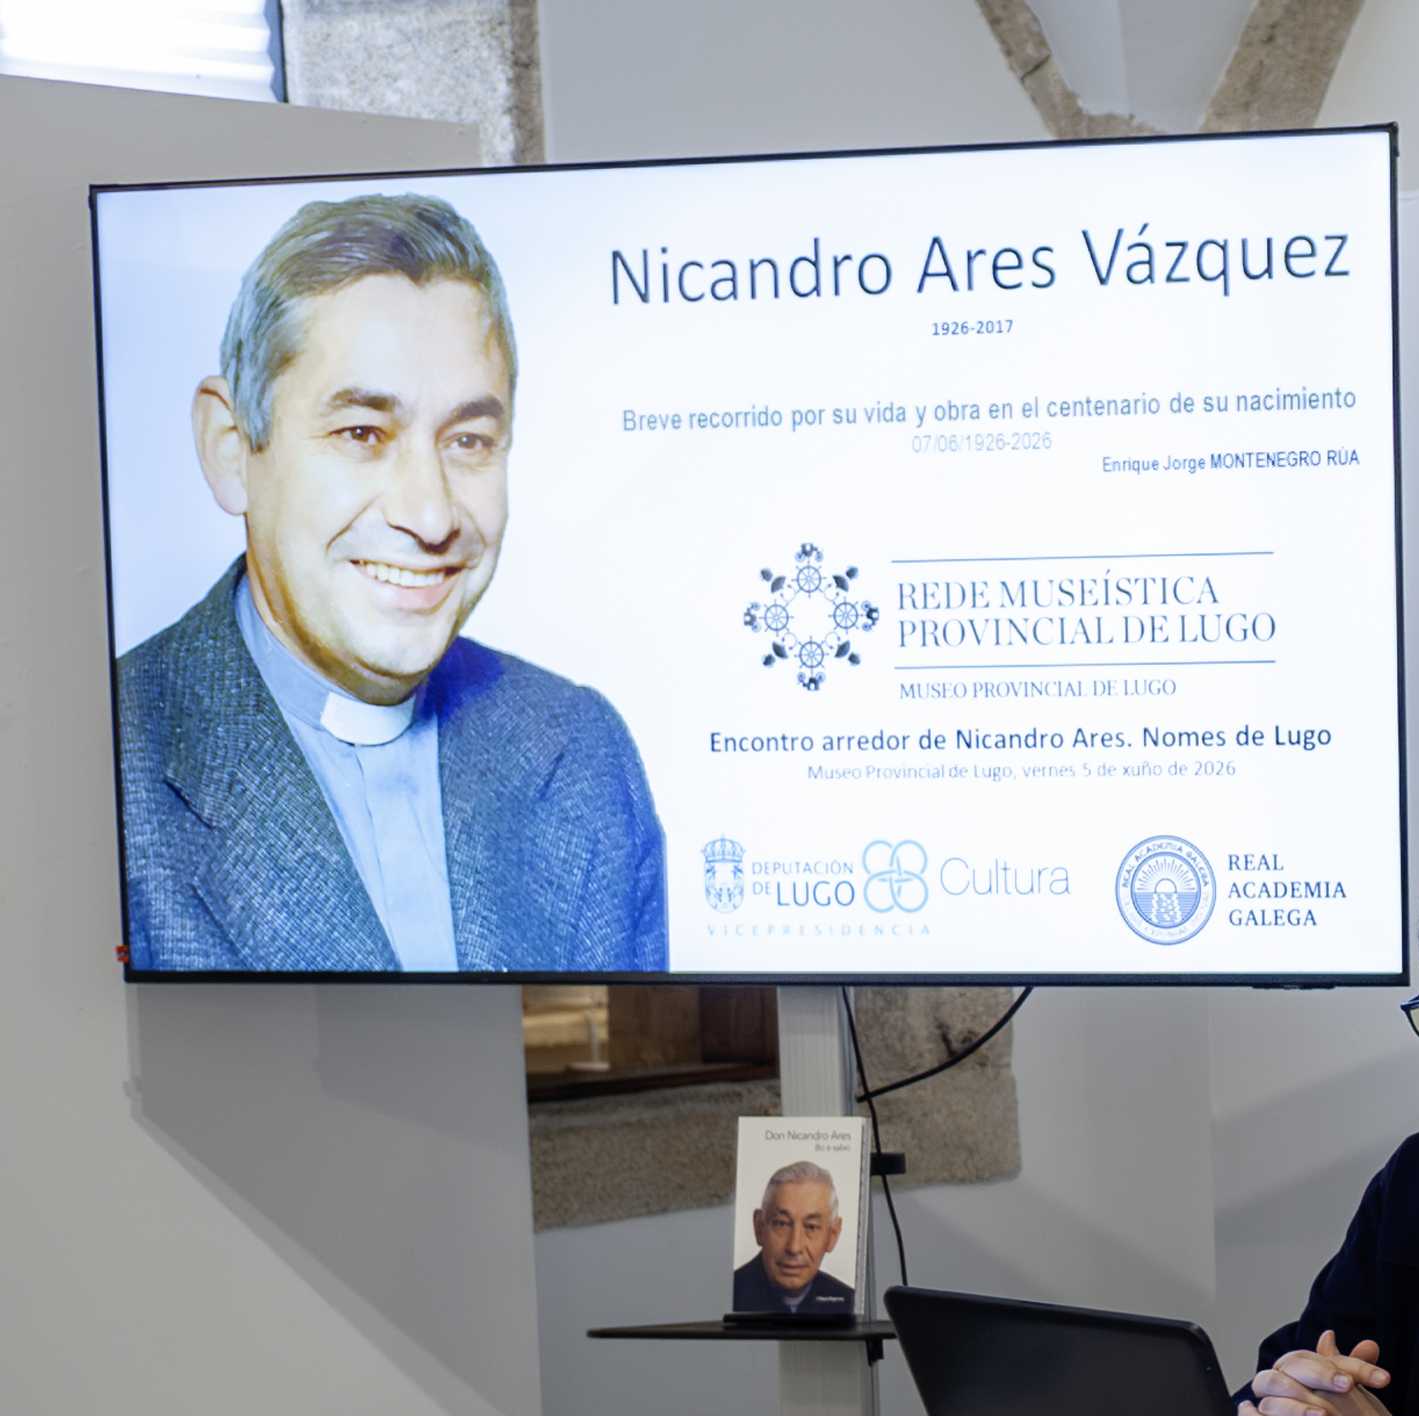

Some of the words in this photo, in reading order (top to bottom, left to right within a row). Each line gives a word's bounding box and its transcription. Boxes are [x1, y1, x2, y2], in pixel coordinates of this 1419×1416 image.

[611, 237, 892, 305] Nicandro
[916, 236, 1056, 294] Ares
[1081, 222, 1350, 297] Vázquez
[932, 319, 1014, 337] 1926-2017
[622, 409, 682, 432] Breve
[688, 404, 783, 430] recorrido
[791, 408, 826, 433] por
[832, 407, 857, 425] su
[863, 400, 907, 424] vida
[915, 405, 927, 429] y
[933, 399, 981, 422] obra
[988, 402, 1013, 420] en
[1021, 396, 1039, 419] el
[1046, 391, 1161, 418] centenario
[1169, 391, 1195, 414] de
[1202, 395, 1229, 413] su
[1236, 386, 1357, 412] nacimiento
[911, 431, 1052, 454] 07/06/1926-2026
[1102, 456, 1160, 475] Enrique
[1162, 455, 1206, 475] Jorge
[1210, 450, 1322, 470] MONTENEGRO
[1326, 449, 1361, 466] RÚA
[898, 581, 990, 610] REDE
[999, 569, 1219, 608] MUSEÍSTICA
[899, 616, 1114, 648] PROVINCIAL
[1123, 615, 1169, 644] DE
[1180, 613, 1276, 643] LUGO
[898, 681, 969, 700] MUSEO
[970, 679, 1090, 700] PROVINCIAL
[1092, 679, 1120, 698] DE
[1122, 678, 1179, 697] LUGO
[710, 732, 814, 753] Encontro
[822, 729, 910, 752] arredor
[918, 728, 947, 750] de
[956, 727, 1064, 750] Nicandro
[1072, 727, 1132, 748] Ares.
[1143, 726, 1227, 748] Nomes
[1235, 724, 1265, 747] de
[1274, 724, 1332, 752] Lugo
[807, 765, 862, 780] Museo
[865, 763, 945, 779] Provincial
[948, 764, 969, 779] de
[973, 764, 1017, 783] Lugo,
[1021, 765, 1076, 778] vernes
[1082, 762, 1092, 777] 5
[1096, 762, 1117, 777] de
[1122, 760, 1163, 777] xuño
[1167, 760, 1189, 776] de
[1194, 760, 1236, 777] 2026
[751, 859, 854, 875] DEPUTACIÓN
[1228, 853, 1284, 871] REAL
[939, 856, 1071, 896] Cultura
[751, 880, 774, 897] DE
[776, 880, 856, 907] LUGO
[1228, 881, 1347, 899] ACADEMIA
[1228, 908, 1318, 927] GALEGA
[706, 923, 931, 937] VICEPRESIDENCIA
[787, 1130, 829, 1141] Nicandro
[831, 1130, 852, 1141] Ares
